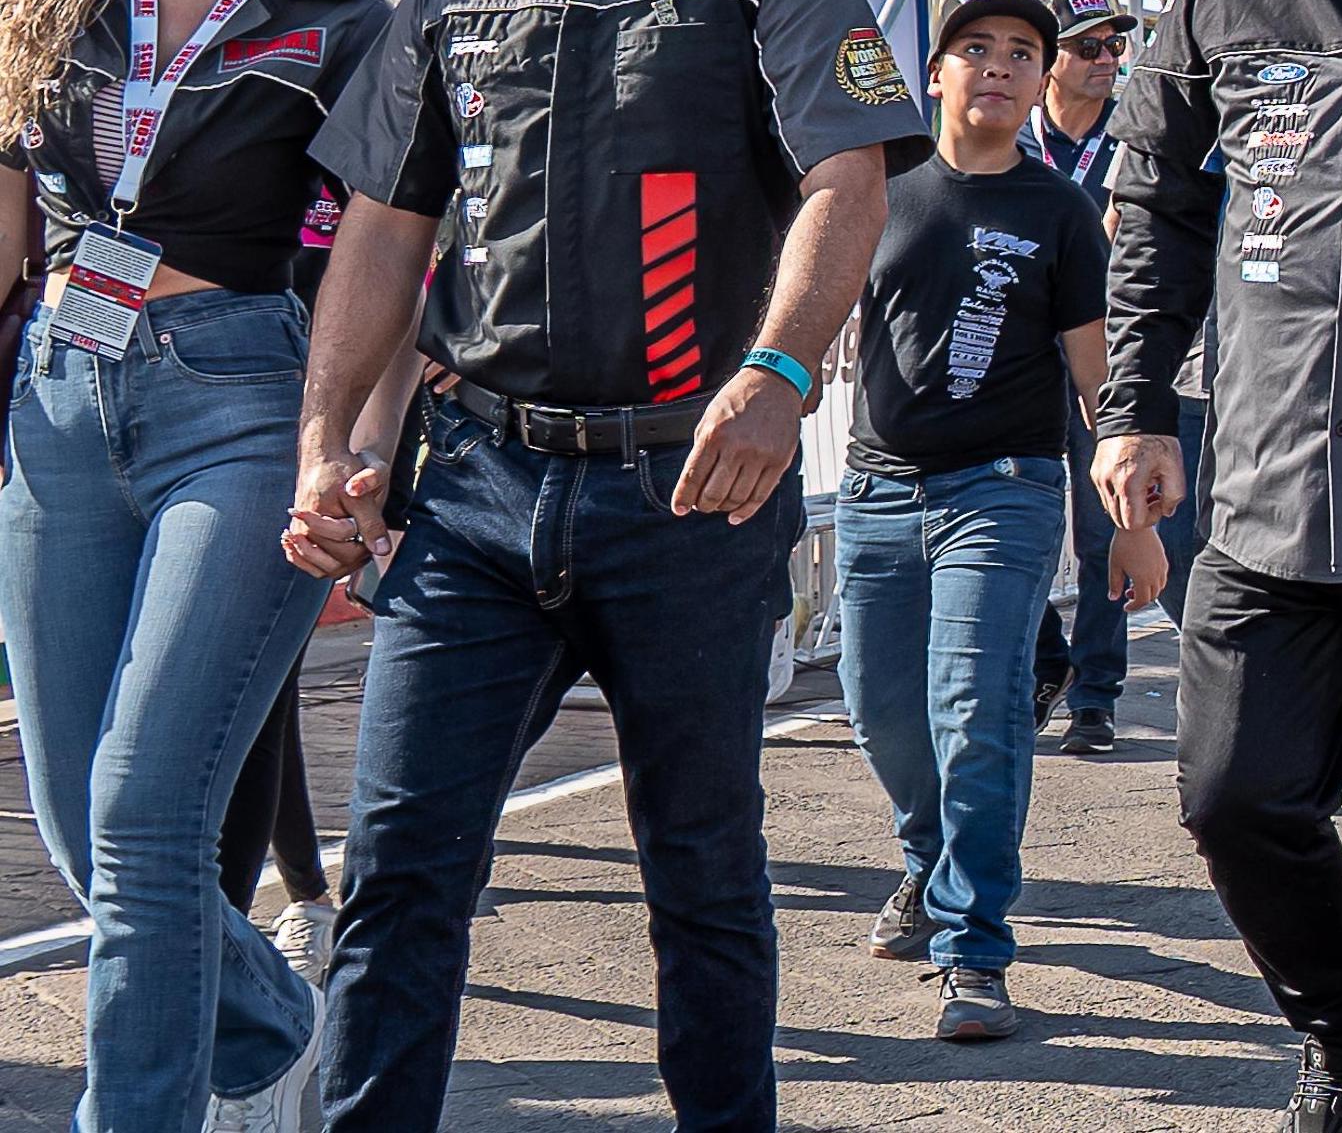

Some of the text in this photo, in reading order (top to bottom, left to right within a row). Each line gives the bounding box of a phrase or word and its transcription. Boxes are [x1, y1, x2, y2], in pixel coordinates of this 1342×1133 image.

[137, 44, 154, 82] SCORE
[163, 43, 199, 82] SCORE
[130, 109, 156, 157] SCORE
